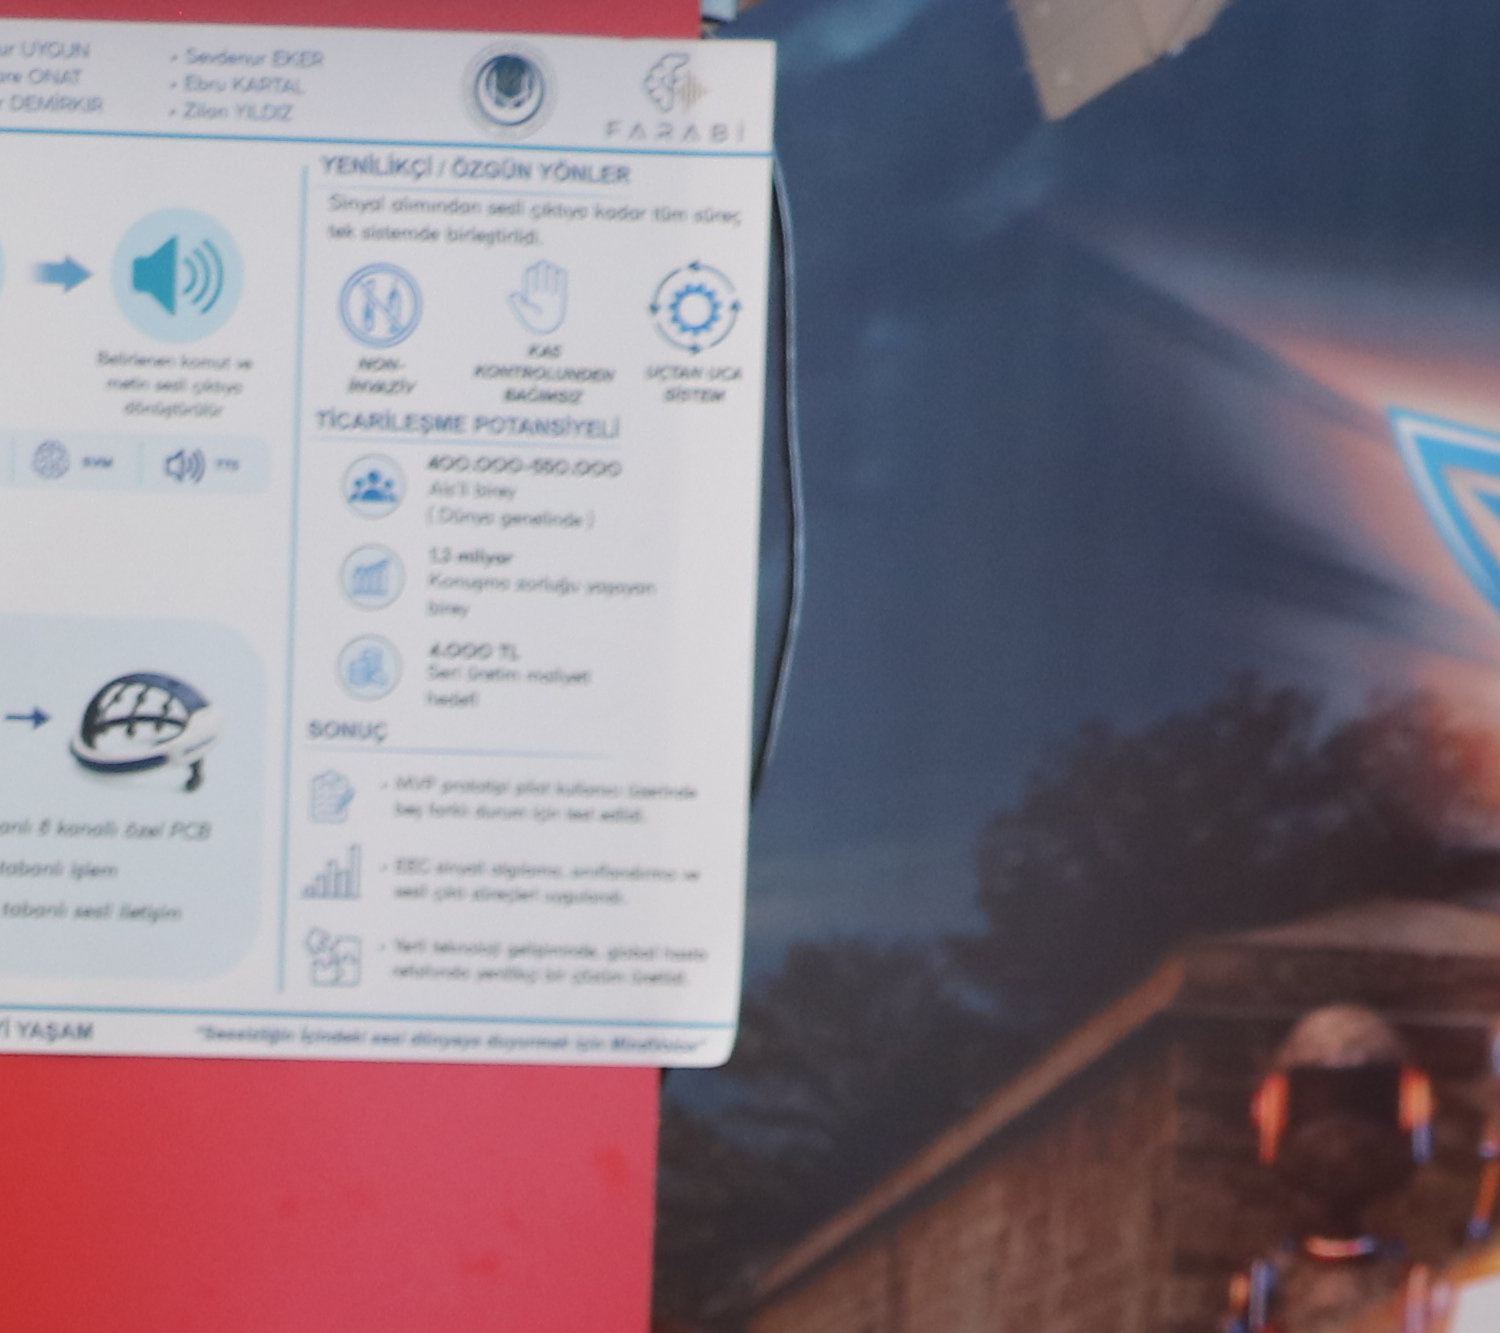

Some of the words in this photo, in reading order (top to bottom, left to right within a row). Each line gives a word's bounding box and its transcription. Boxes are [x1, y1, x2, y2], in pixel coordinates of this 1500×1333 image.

[605, 120, 744, 144] FARABİ
[321, 155, 433, 180] YENİLİKÇİ
[451, 156, 532, 180] ÖZGÜN
[539, 160, 630, 185] YÖNLER
[316, 410, 465, 435] TİCARİLEŞME
[473, 415, 620, 439] POTANSİYELİ
[308, 720, 387, 744] SONUÇ
[17, 1021, 94, 1043] YAŞAM
